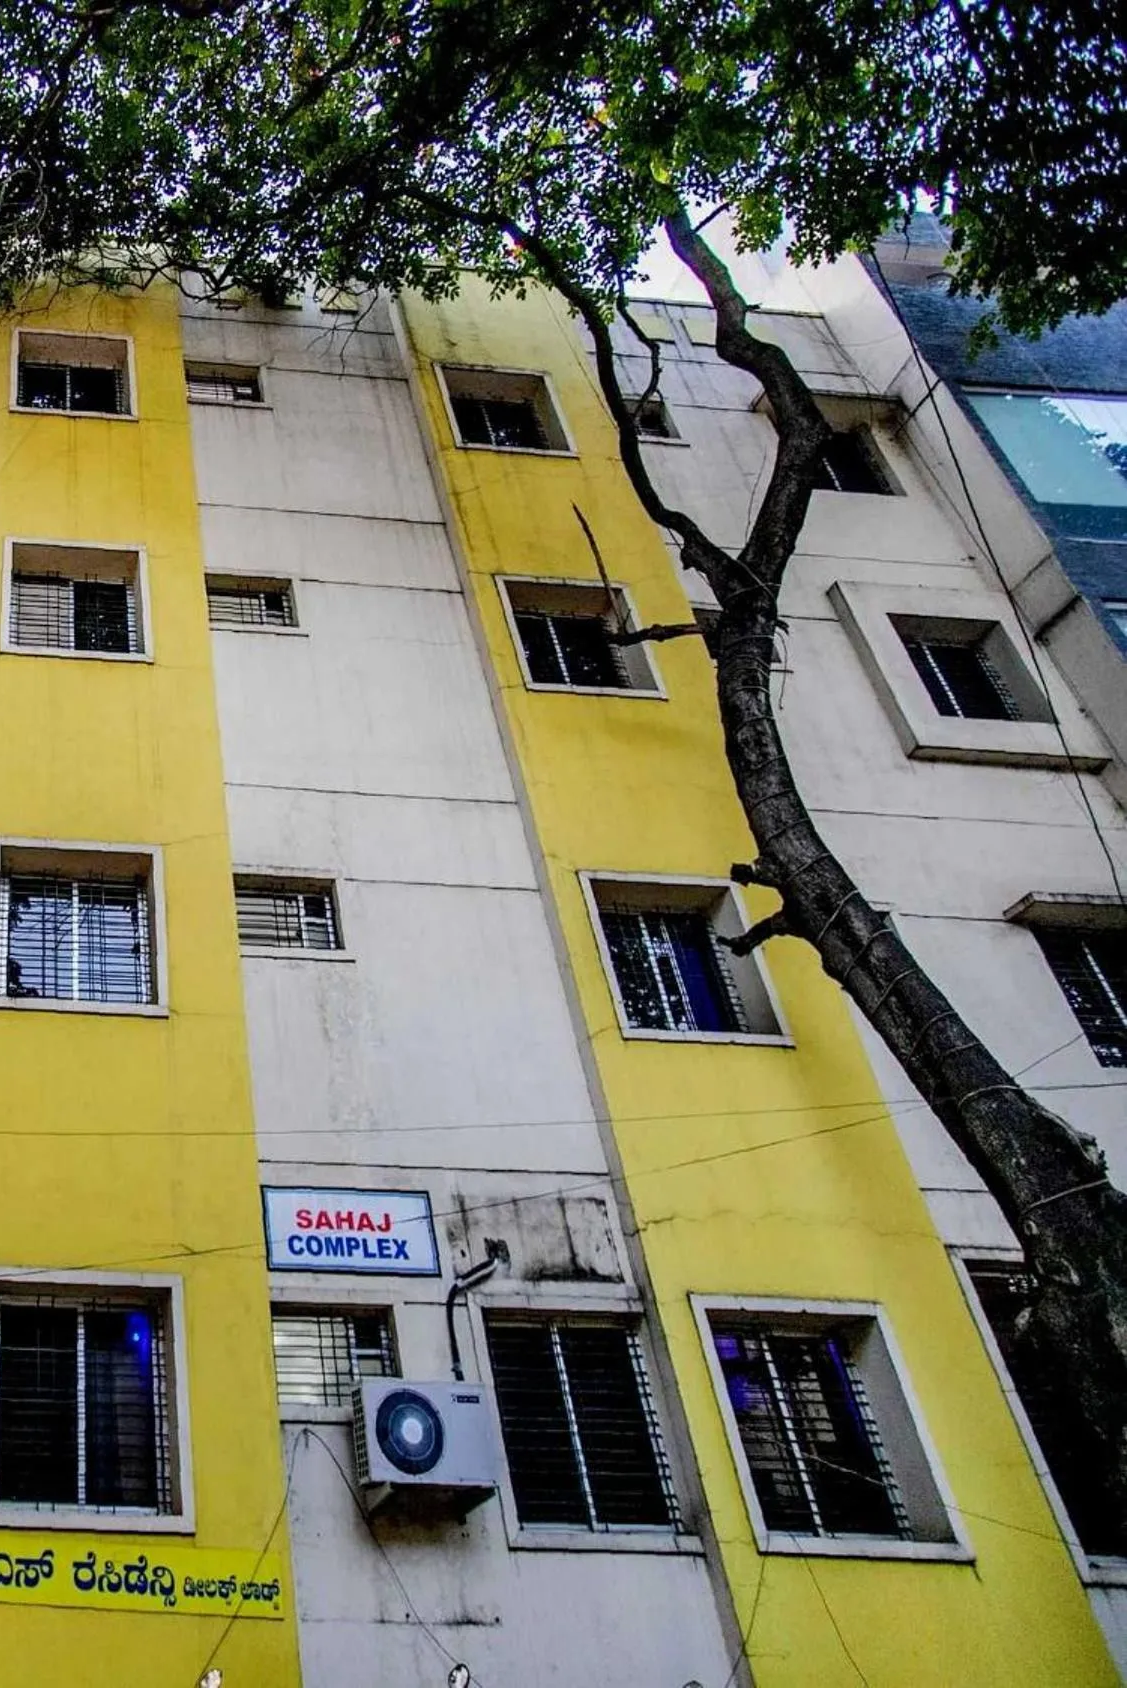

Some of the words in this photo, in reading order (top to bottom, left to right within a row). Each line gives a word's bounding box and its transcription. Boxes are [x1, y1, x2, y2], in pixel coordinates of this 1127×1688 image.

[295, 1209, 392, 1233] SAHAJ
[287, 1234, 410, 1261] COMPLEX
[72, 1550, 178, 1608] ರೆಸಿಡೆನ್ಸಿ
